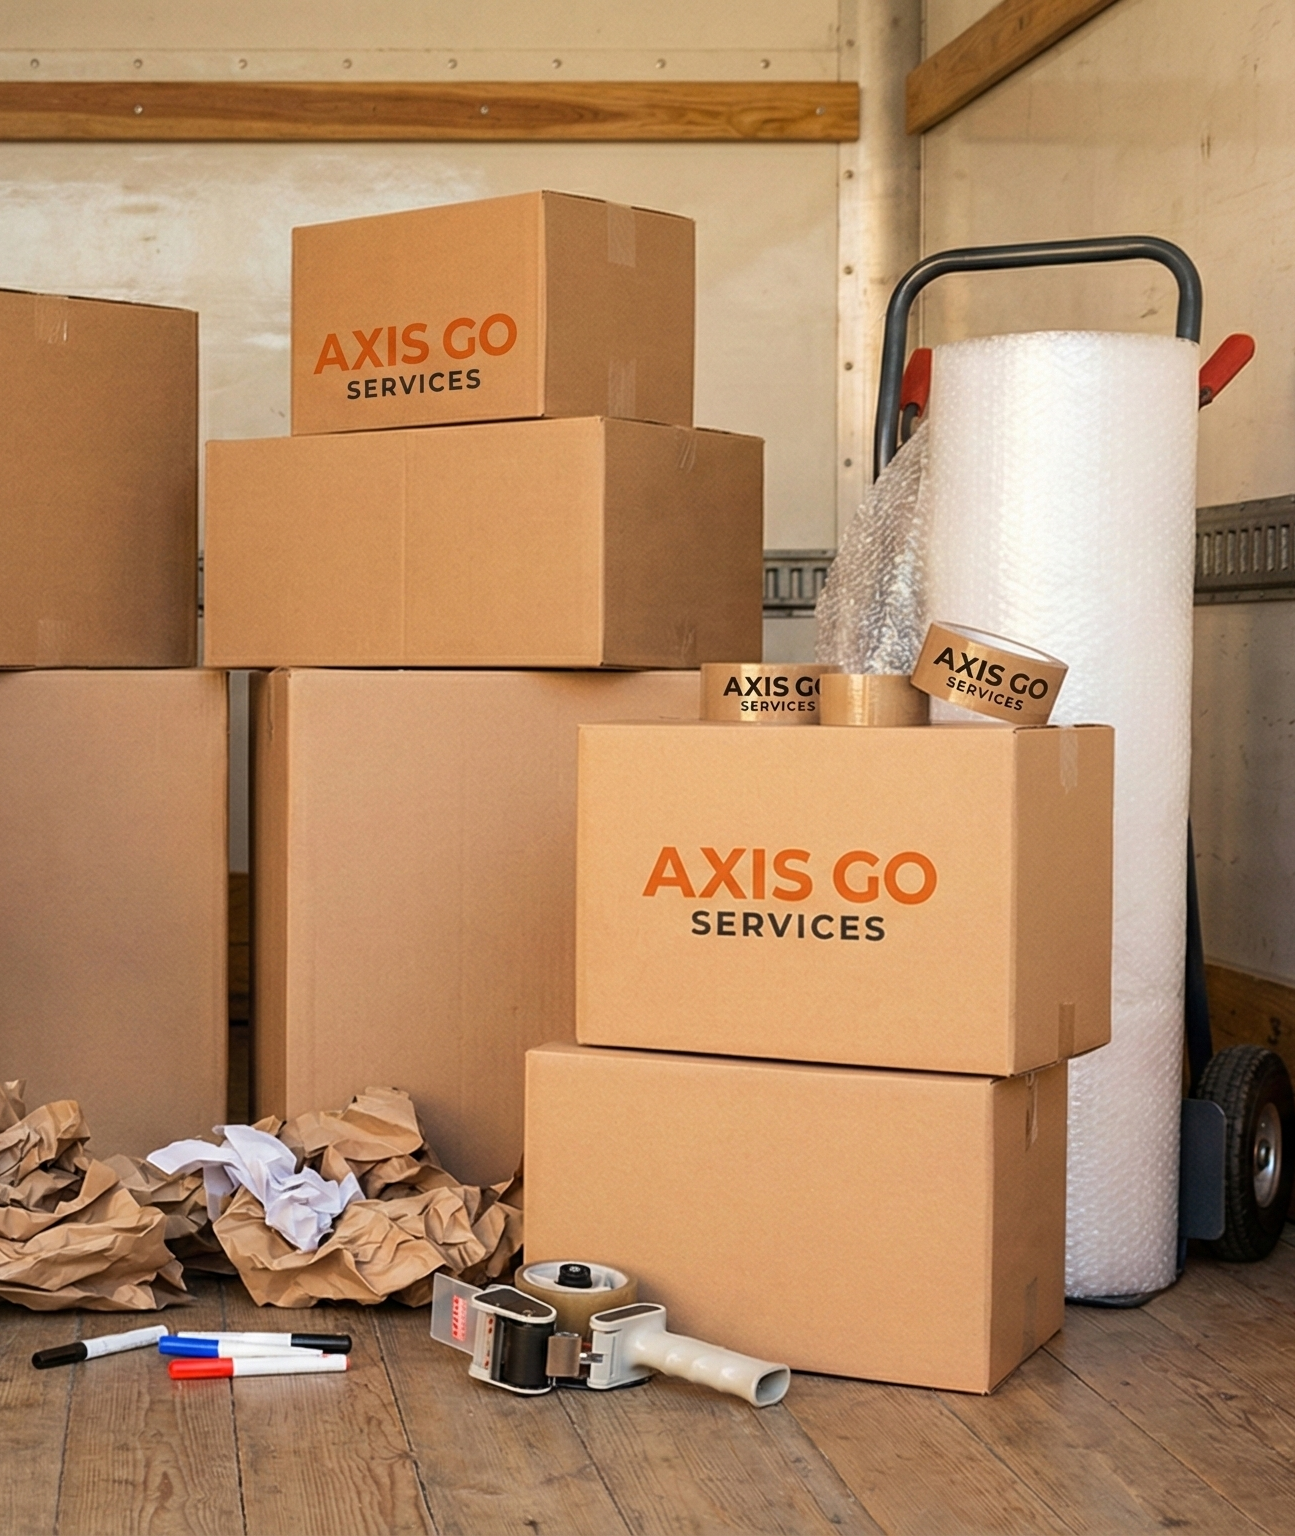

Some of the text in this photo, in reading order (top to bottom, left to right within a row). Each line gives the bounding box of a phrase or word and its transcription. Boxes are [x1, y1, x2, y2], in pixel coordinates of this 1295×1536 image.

[313, 313, 518, 375] AXIS GO
[347, 368, 481, 400] SERVICES
[723, 676, 821, 697] AXIS G
[933, 646, 1049, 701] AXIS GO
[740, 700, 816, 712] SERVICES
[946, 676, 1024, 711] SERVICES
[642, 846, 938, 905] AXIS GO
[691, 910, 886, 942] SERVICES
